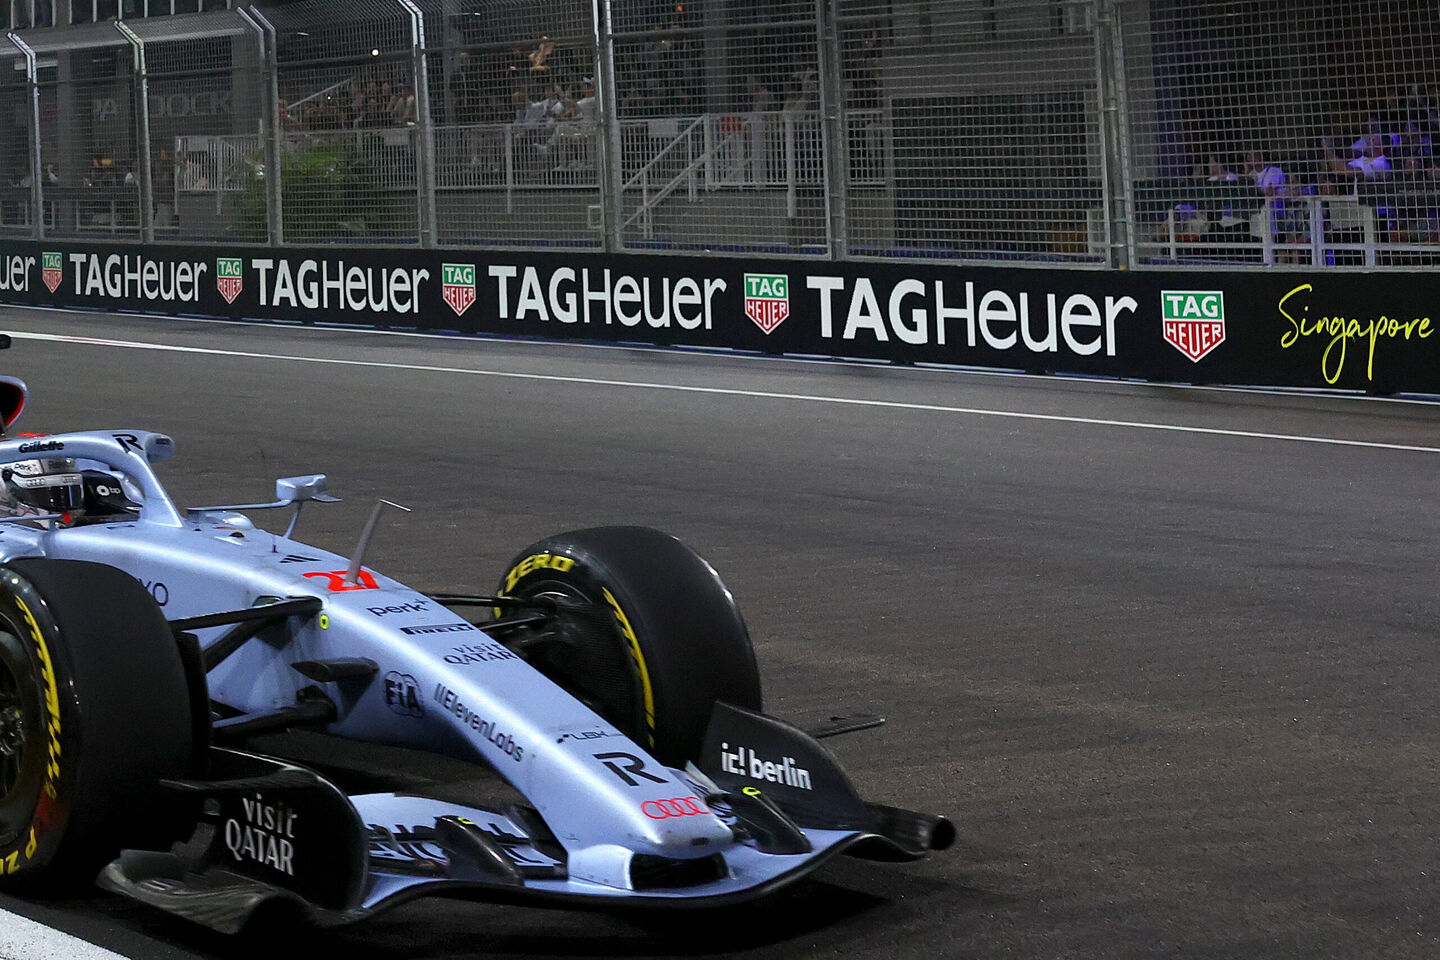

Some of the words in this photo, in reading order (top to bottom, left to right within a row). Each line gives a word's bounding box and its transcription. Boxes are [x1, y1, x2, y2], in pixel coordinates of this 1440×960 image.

[44, 255, 61, 268] TAG
[219, 261, 240, 276] TAG
[444, 267, 472, 284] TAG
[747, 277, 785, 297] TAG
[444, 287, 474, 311] HEUER
[1166, 295, 1219, 318] TAG
[747, 300, 787, 330] HEUER
[1166, 322, 1222, 357] HEUER
[1278, 283, 1433, 385] Singapore
[18, 440, 65, 455] Gillette
[504, 553, 576, 593] ZERO
[400, 623, 476, 636] PIRELLI
[443, 650, 518, 666] QATAR
[451, 642, 503, 655] visit
[384, 678, 423, 711] FIA
[721, 742, 746, 776] ic!
[748, 748, 813, 790] berlin
[242, 793, 298, 839] visit
[224, 819, 295, 876] QATAR
